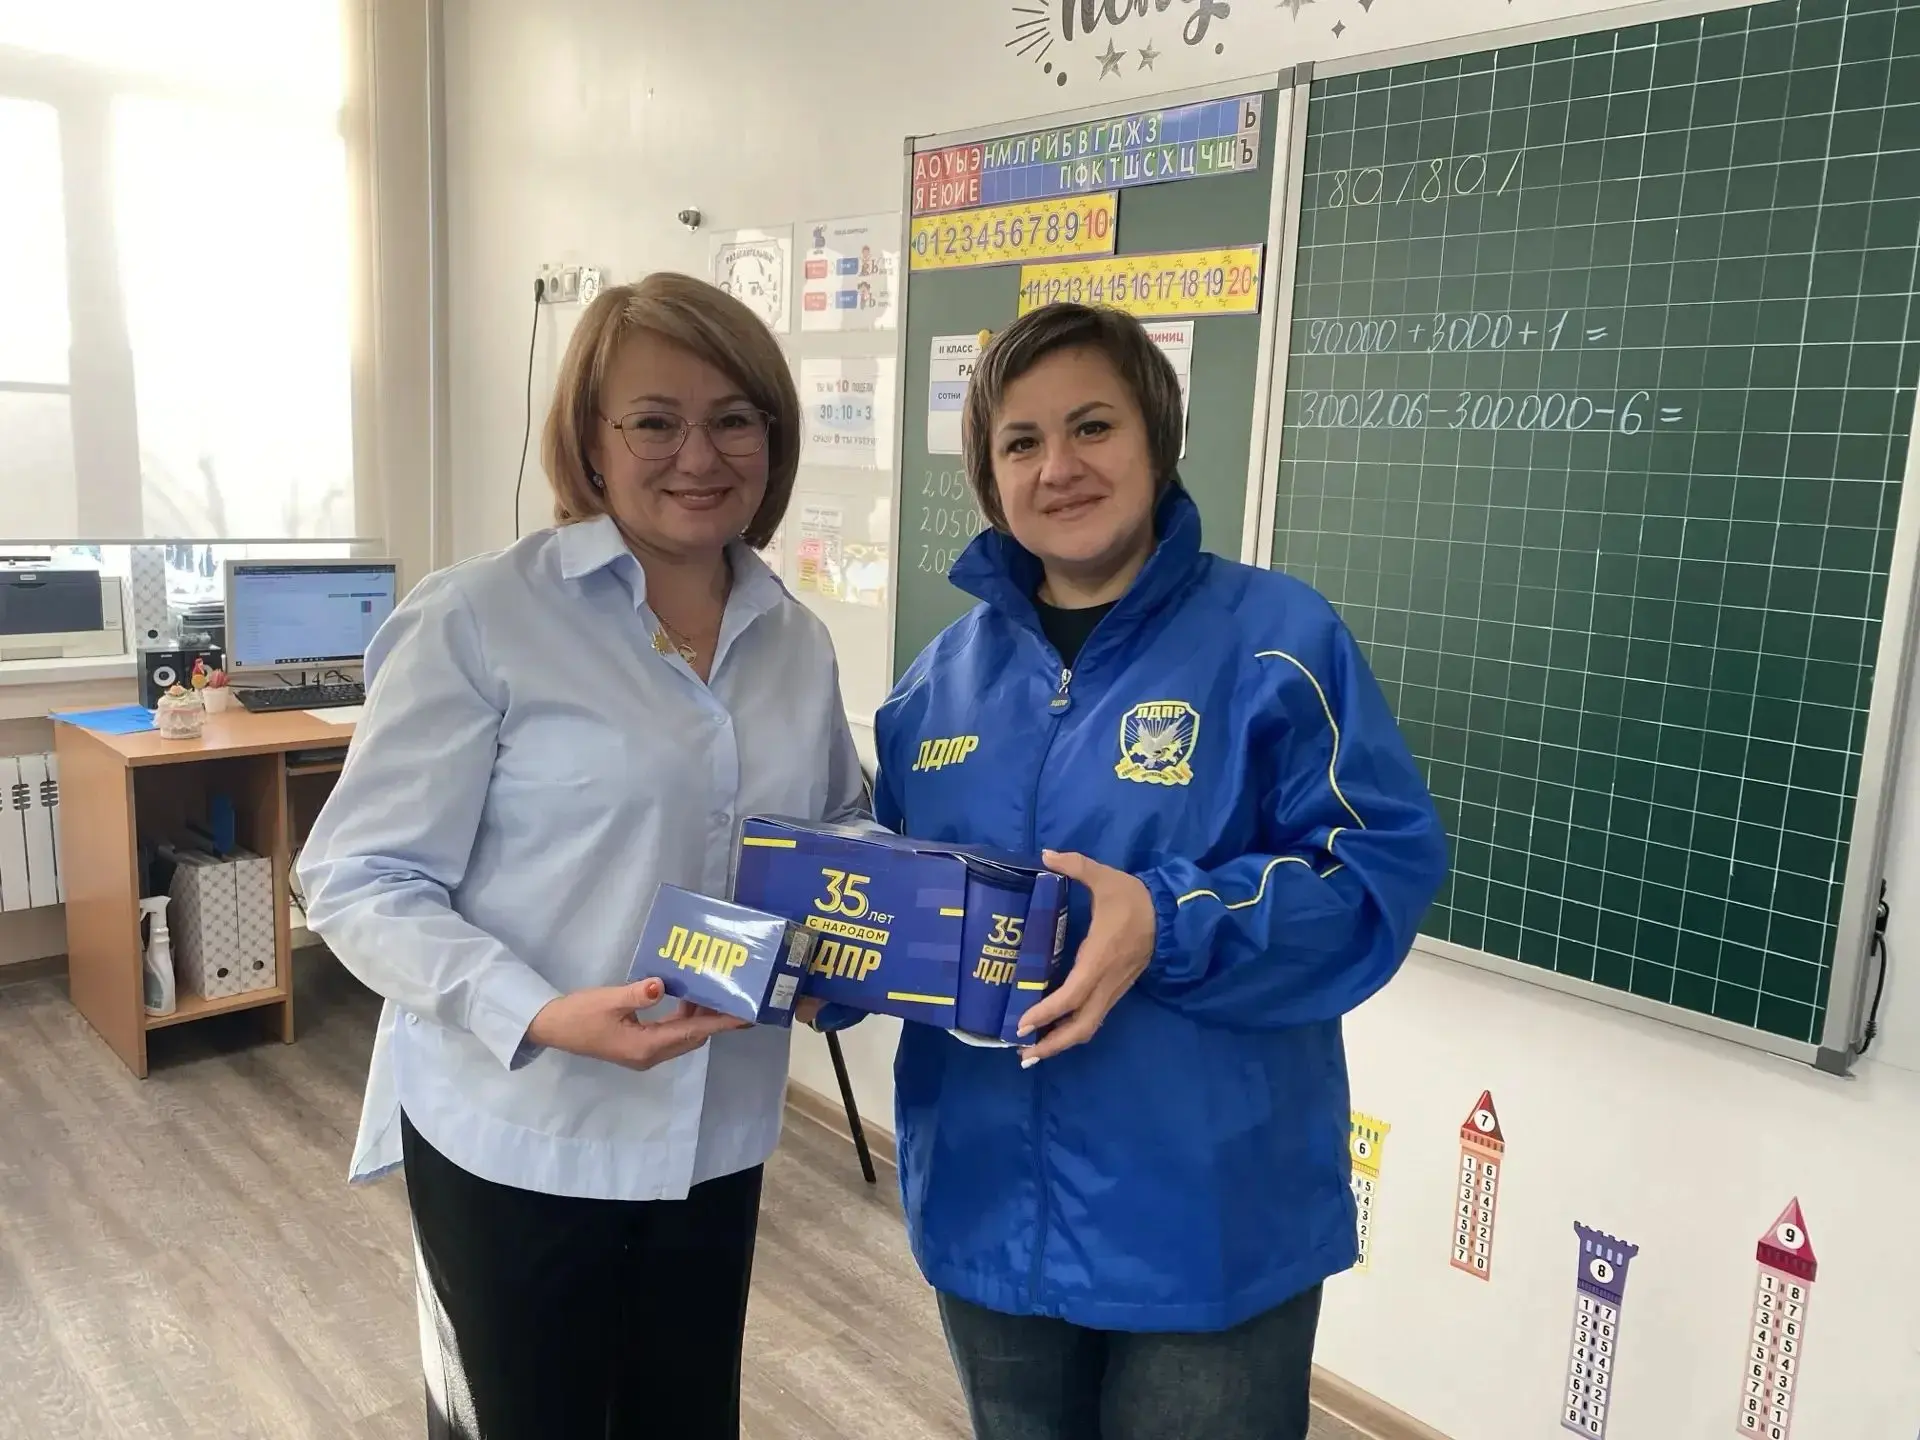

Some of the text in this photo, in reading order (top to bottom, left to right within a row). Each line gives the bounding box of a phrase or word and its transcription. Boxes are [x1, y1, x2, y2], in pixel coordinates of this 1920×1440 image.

[1026, 266, 1252, 305] 11 12 13 14 15 16 17 18 19 20
[1307, 319, 1397, 354] 90000
[1427, 312, 1512, 353] 3000
[946, 345, 973, 354] КЛАСС
[836, 379, 849, 392] 10
[938, 392, 961, 400] СОТНИ
[820, 404, 872, 420] 30 10 3
[1134, 706, 1186, 720] ЛДПР
[911, 735, 979, 772] ЛДПР
[814, 867, 895, 925] 35 лет
[809, 919, 886, 942] С НАРОДОМ
[987, 914, 1024, 946] 35
[658, 925, 749, 978] ЛДПР
[808, 939, 882, 982] ДПР
[993, 948, 1017, 958] НАРО
[1481, 1113, 1489, 1127] 7
[1359, 1142, 1366, 1155] 6
[1467, 1158, 1493, 1176] 1 6
[1365, 1181, 1371, 1192] 5
[1465, 1172, 1491, 1192] 2 5
[1363, 1196, 1370, 1207] 4
[1464, 1188, 1490, 1208] 3 4
[1362, 1210, 1369, 1221] 3
[1462, 1204, 1489, 1223] 4 3
[1460, 1219, 1487, 1239] 5 2
[1785, 1228, 1796, 1243] 9
[1459, 1234, 1485, 1254] 6 1
[1458, 1249, 1484, 1269] 7 0
[1597, 1264, 1606, 1278] 8
[1766, 1277, 1800, 1300] 1 8
[1583, 1299, 1612, 1320] 1 7
[1763, 1294, 1798, 1317] 2 7
[1580, 1314, 1610, 1337] 2 6
[1761, 1311, 1796, 1336] 3 6
[1579, 1330, 1608, 1353] 3 5
[1758, 1330, 1793, 1353] 4 5
[1577, 1347, 1606, 1369] 4 4
[1756, 1346, 1790, 1371] 5 4
[1575, 1362, 1604, 1385] 5 3
[1753, 1364, 1788, 1388] 6 3
[1573, 1378, 1602, 1401] 6 2
[1751, 1380, 1786, 1406] 7 2
[1571, 1393, 1599, 1417] 7 1
[1748, 1398, 1782, 1423] 8 1
[1569, 1409, 1598, 1433] 8 0
[1746, 1415, 1781, 1440] 9 0
